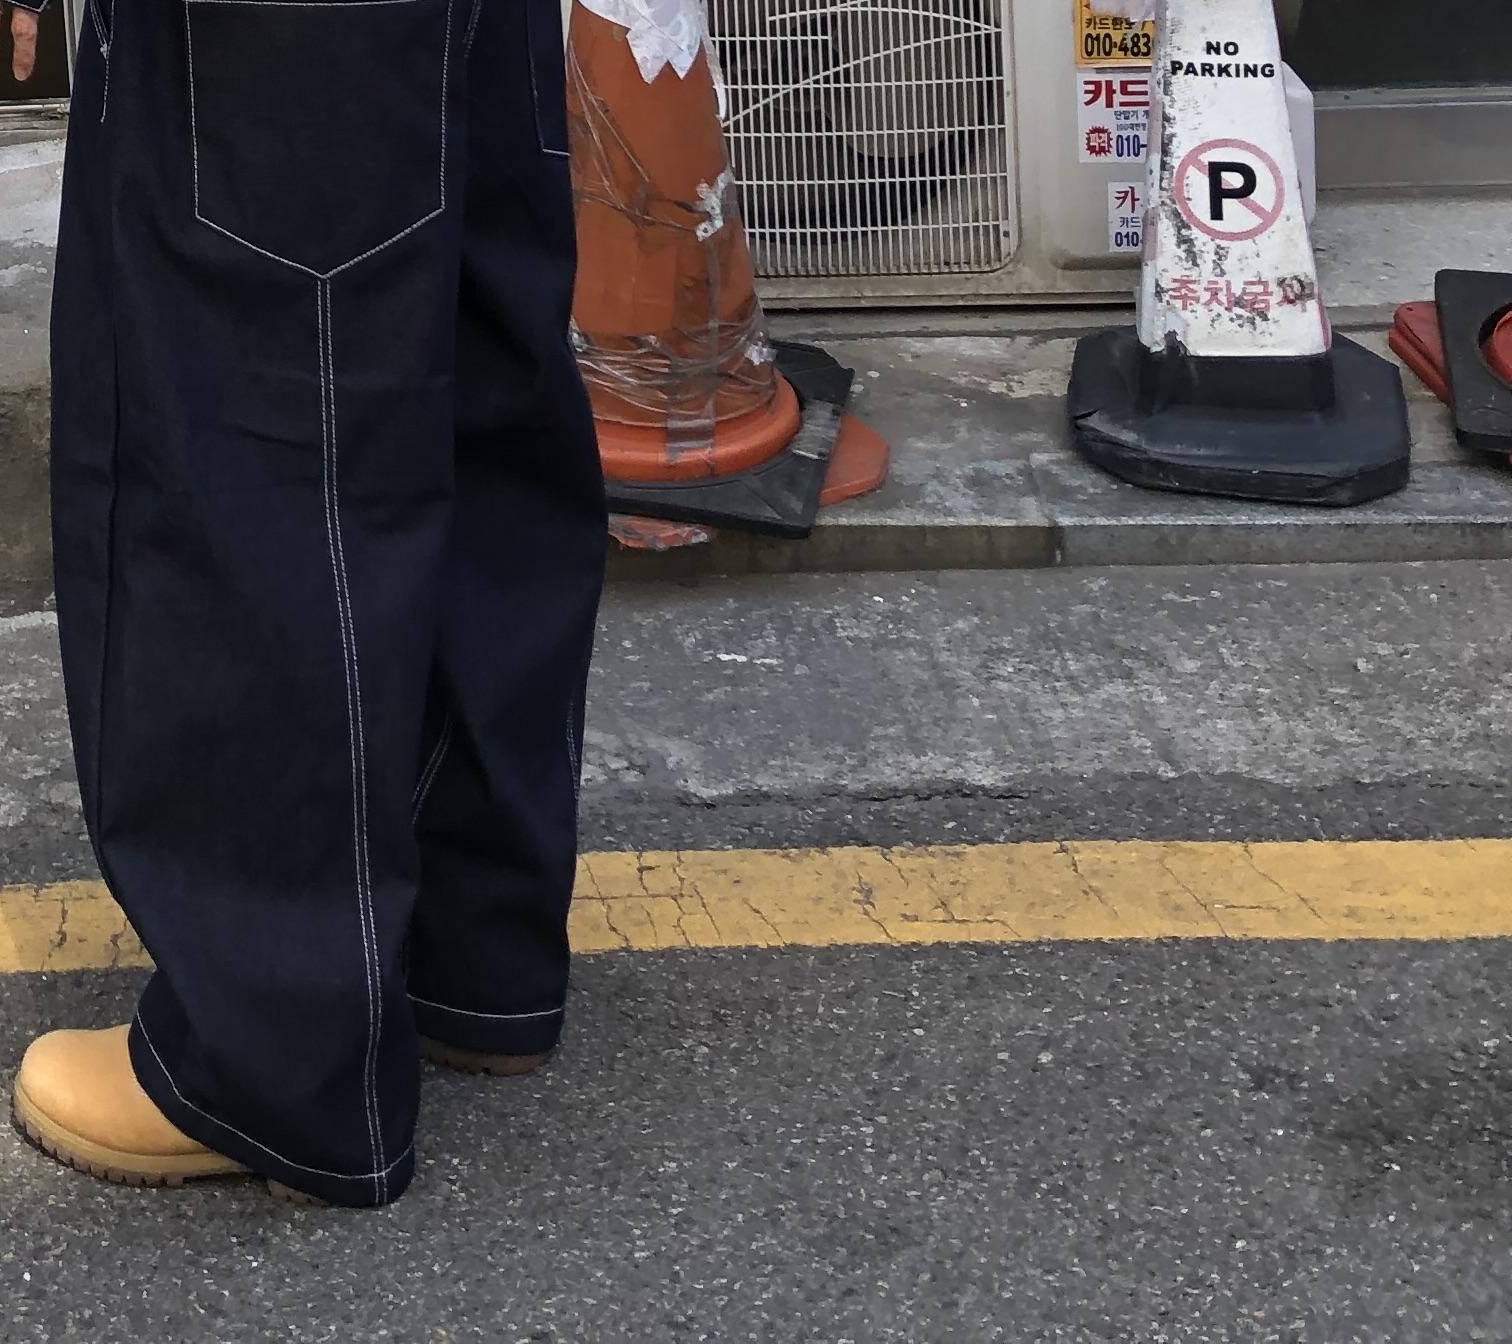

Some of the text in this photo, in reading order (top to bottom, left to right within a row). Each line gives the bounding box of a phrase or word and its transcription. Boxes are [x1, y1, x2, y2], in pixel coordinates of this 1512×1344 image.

[1085, 33, 1154, 56] 010-483
[1206, 41, 1239, 56] NO
[1170, 60, 1275, 78] PARKING
[1114, 186, 1143, 213] 카
[1208, 162, 1257, 221] P
